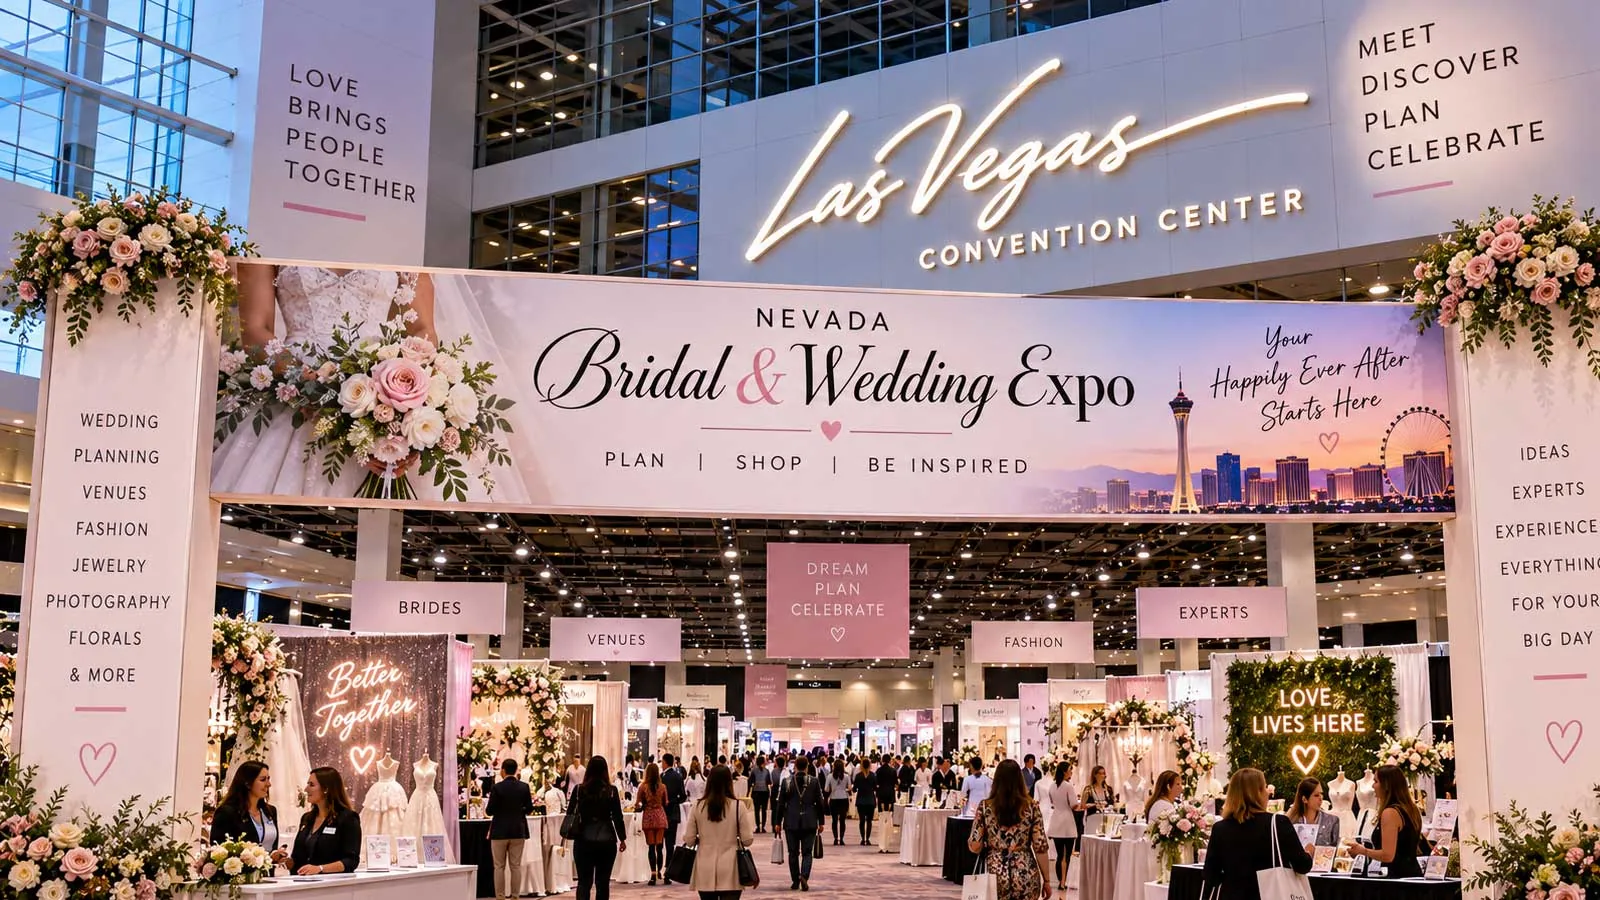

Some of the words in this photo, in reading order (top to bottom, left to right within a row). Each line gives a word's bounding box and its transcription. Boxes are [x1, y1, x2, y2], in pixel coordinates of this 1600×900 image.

[1359, 22, 1435, 59] MEET
[290, 63, 359, 98] LOVE
[1362, 46, 1519, 96] DISCOVER
[288, 95, 387, 135] BRINGS
[1365, 100, 1440, 133] PLAN
[286, 128, 385, 166] PEOPLE
[1368, 120, 1545, 170] CELEBRATE
[745, 110, 904, 261] Las
[876, 58, 1309, 231] Vegas
[284, 159, 416, 204] TOGETHER
[919, 215, 1138, 270] CONVENTION
[1158, 188, 1305, 231] CENTER
[756, 307, 890, 332] NEVADA
[1266, 324, 1313, 359] Your
[533, 327, 733, 409] Bridal
[736, 347, 787, 406] &
[789, 343, 999, 429] Wedding
[1008, 344, 1135, 423] Expo
[1210, 361, 1292, 401] Happily
[1299, 355, 1346, 385] Ever
[1353, 346, 1409, 380] After
[1261, 395, 1326, 432] Starts
[1333, 386, 1382, 418] Here
[80, 413, 159, 429] WEDDING
[74, 448, 159, 465] PLANNING
[1520, 444, 1570, 461] IDEAS
[605, 451, 665, 468] PLAN
[736, 455, 802, 472] SHOP
[868, 457, 896, 473] BE
[911, 457, 1028, 475] INSPIRED
[83, 485, 147, 500] VENUES
[1513, 481, 1585, 500] EXPERTS
[76, 521, 148, 537] FASHION
[1496, 519, 1598, 539] EXPERIENCE
[72, 558, 147, 573] JEWELRY
[807, 562, 868, 575] DREAM
[1501, 557, 1600, 576] EVERYTHIN
[815, 582, 860, 595] PLAN
[46, 594, 171, 609] PHOTOGRAPHY
[399, 601, 461, 615] BRIDES
[791, 603, 885, 616] CELEBRATE
[1512, 596, 1544, 611] FOR
[1552, 593, 1600, 609] YOUR
[1179, 605, 1249, 620] EXPERTS
[69, 630, 142, 646] FLORALS
[587, 633, 646, 646] VENUES
[1004, 637, 1063, 649] FASHION
[1523, 632, 1552, 647] BIG
[1561, 631, 1593, 646] DAY
[70, 668, 80, 682] &
[88, 667, 136, 682] MORE
[326, 660, 402, 698] Better
[1280, 687, 1331, 708] LOVE
[315, 689, 417, 742] Together
[1253, 714, 1305, 734] LIVES
[1313, 713, 1366, 733] HERE
